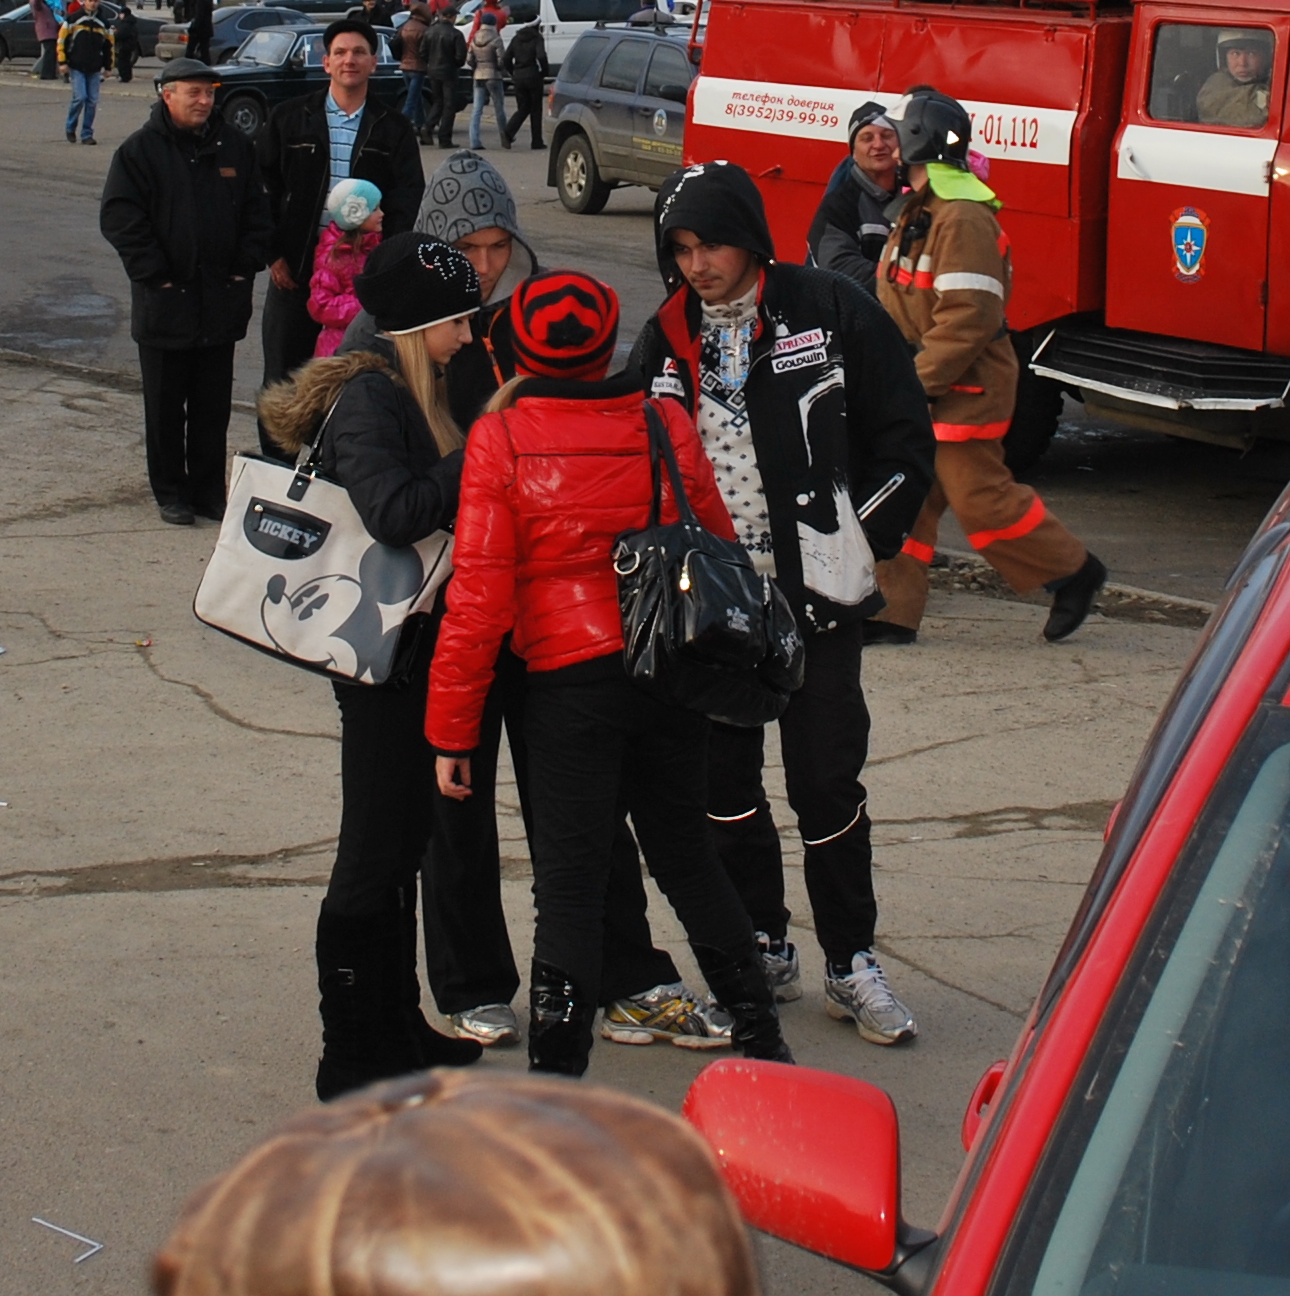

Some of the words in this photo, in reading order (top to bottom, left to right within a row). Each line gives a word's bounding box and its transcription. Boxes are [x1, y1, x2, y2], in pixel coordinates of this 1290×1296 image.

[732, 90, 785, 106] телефон
[787, 96, 835, 112] доверия
[725, 103, 839, 128] 8(3952)39-99-99
